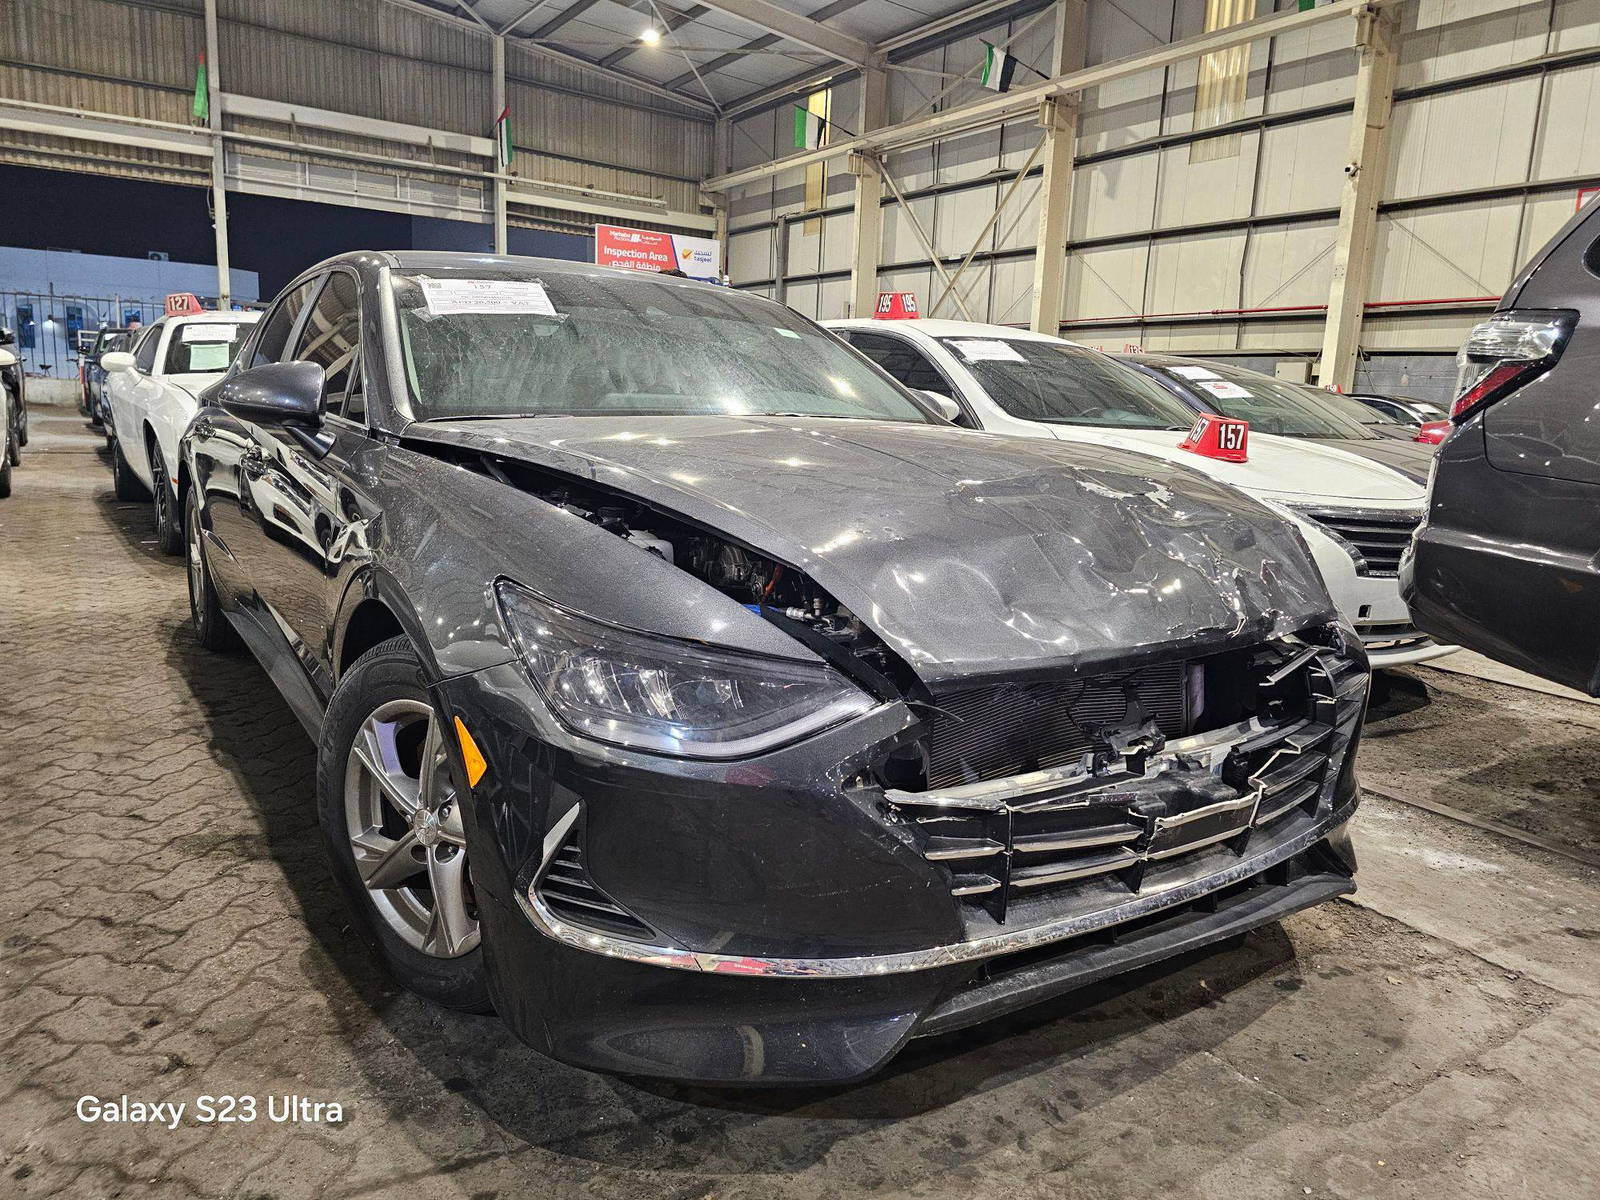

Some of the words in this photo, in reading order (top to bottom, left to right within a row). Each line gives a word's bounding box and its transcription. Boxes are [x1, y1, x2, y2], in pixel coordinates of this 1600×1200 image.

[604, 245, 647, 259] Inspection
[649, 251, 668, 262] Area
[169, 295, 189, 311] 127
[902, 294, 916, 312] 195
[1220, 423, 1245, 450] 157
